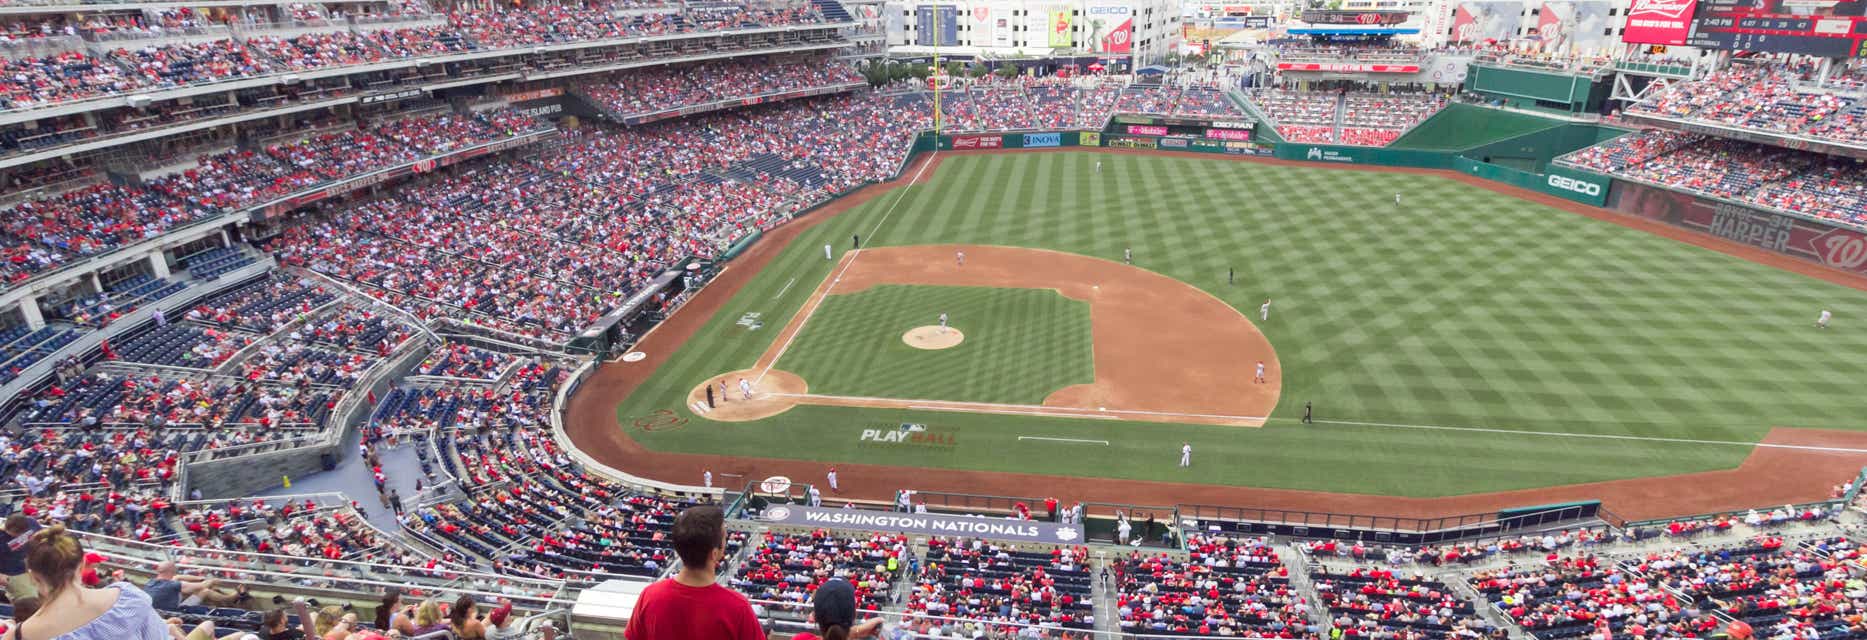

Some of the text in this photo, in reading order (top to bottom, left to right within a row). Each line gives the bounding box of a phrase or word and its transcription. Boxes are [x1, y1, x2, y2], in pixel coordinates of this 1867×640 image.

[1090, 7, 1128, 15] GEICO
[1032, 134, 1060, 145] INOVA
[1548, 175, 1600, 196] GEICO
[1713, 203, 1793, 231] BRYCE 34
[1709, 216, 1791, 252] HARPER
[860, 429, 910, 443] PLAY
[805, 511, 1039, 537] WASHINGTON NATIONALS
